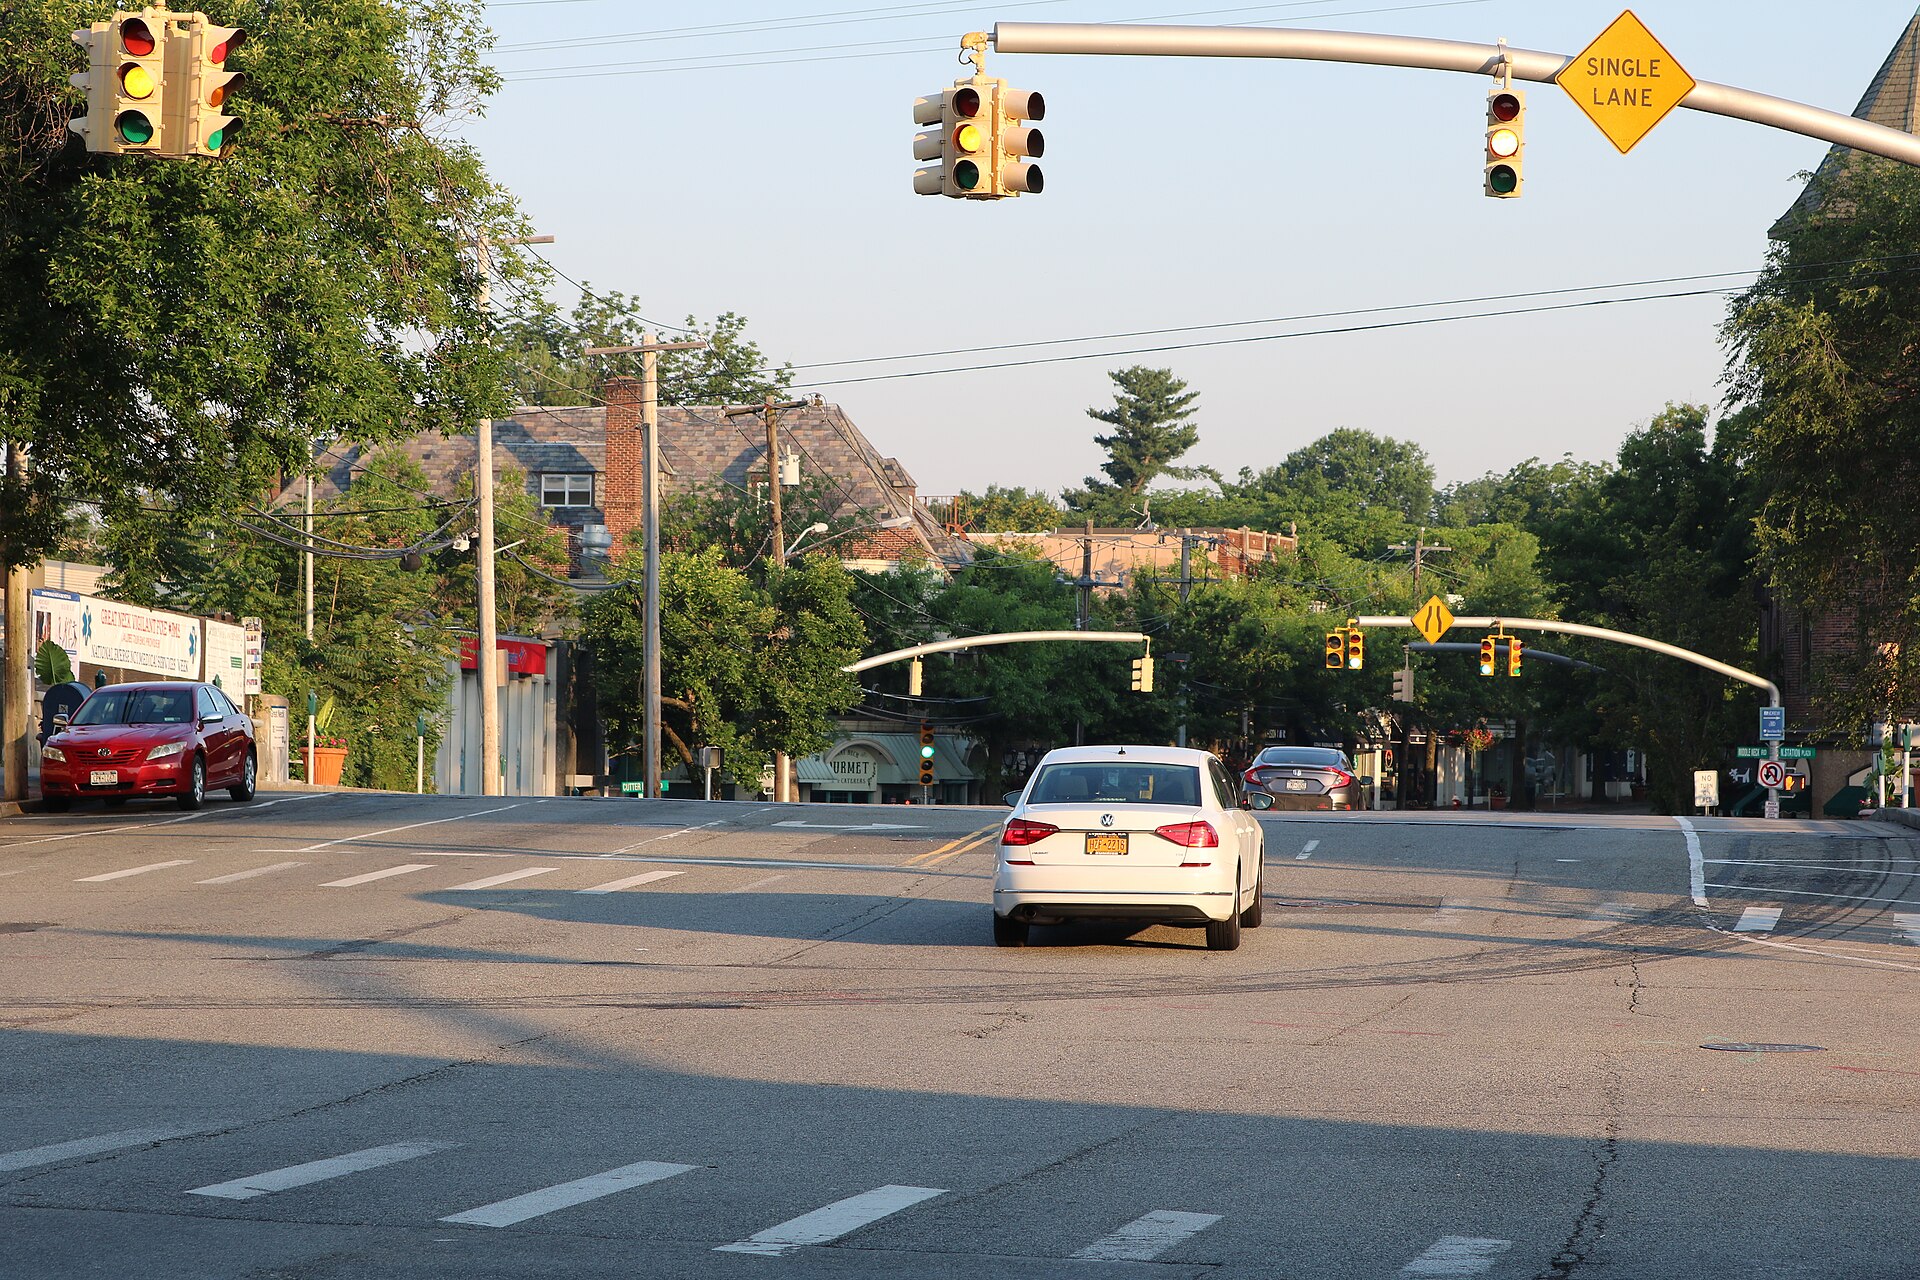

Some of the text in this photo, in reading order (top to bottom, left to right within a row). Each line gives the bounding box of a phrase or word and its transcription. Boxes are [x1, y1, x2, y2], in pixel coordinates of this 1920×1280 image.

[1586, 57, 1660, 78] SINGLE
[1593, 87, 1652, 107] LANE
[101, 608, 116, 626] GREAT
[117, 612, 130, 628] NECK
[132, 615, 156, 633] VIGILANT
[91, 644, 112, 660] NATIONAL
[622, 782, 641, 791] CUTTER
